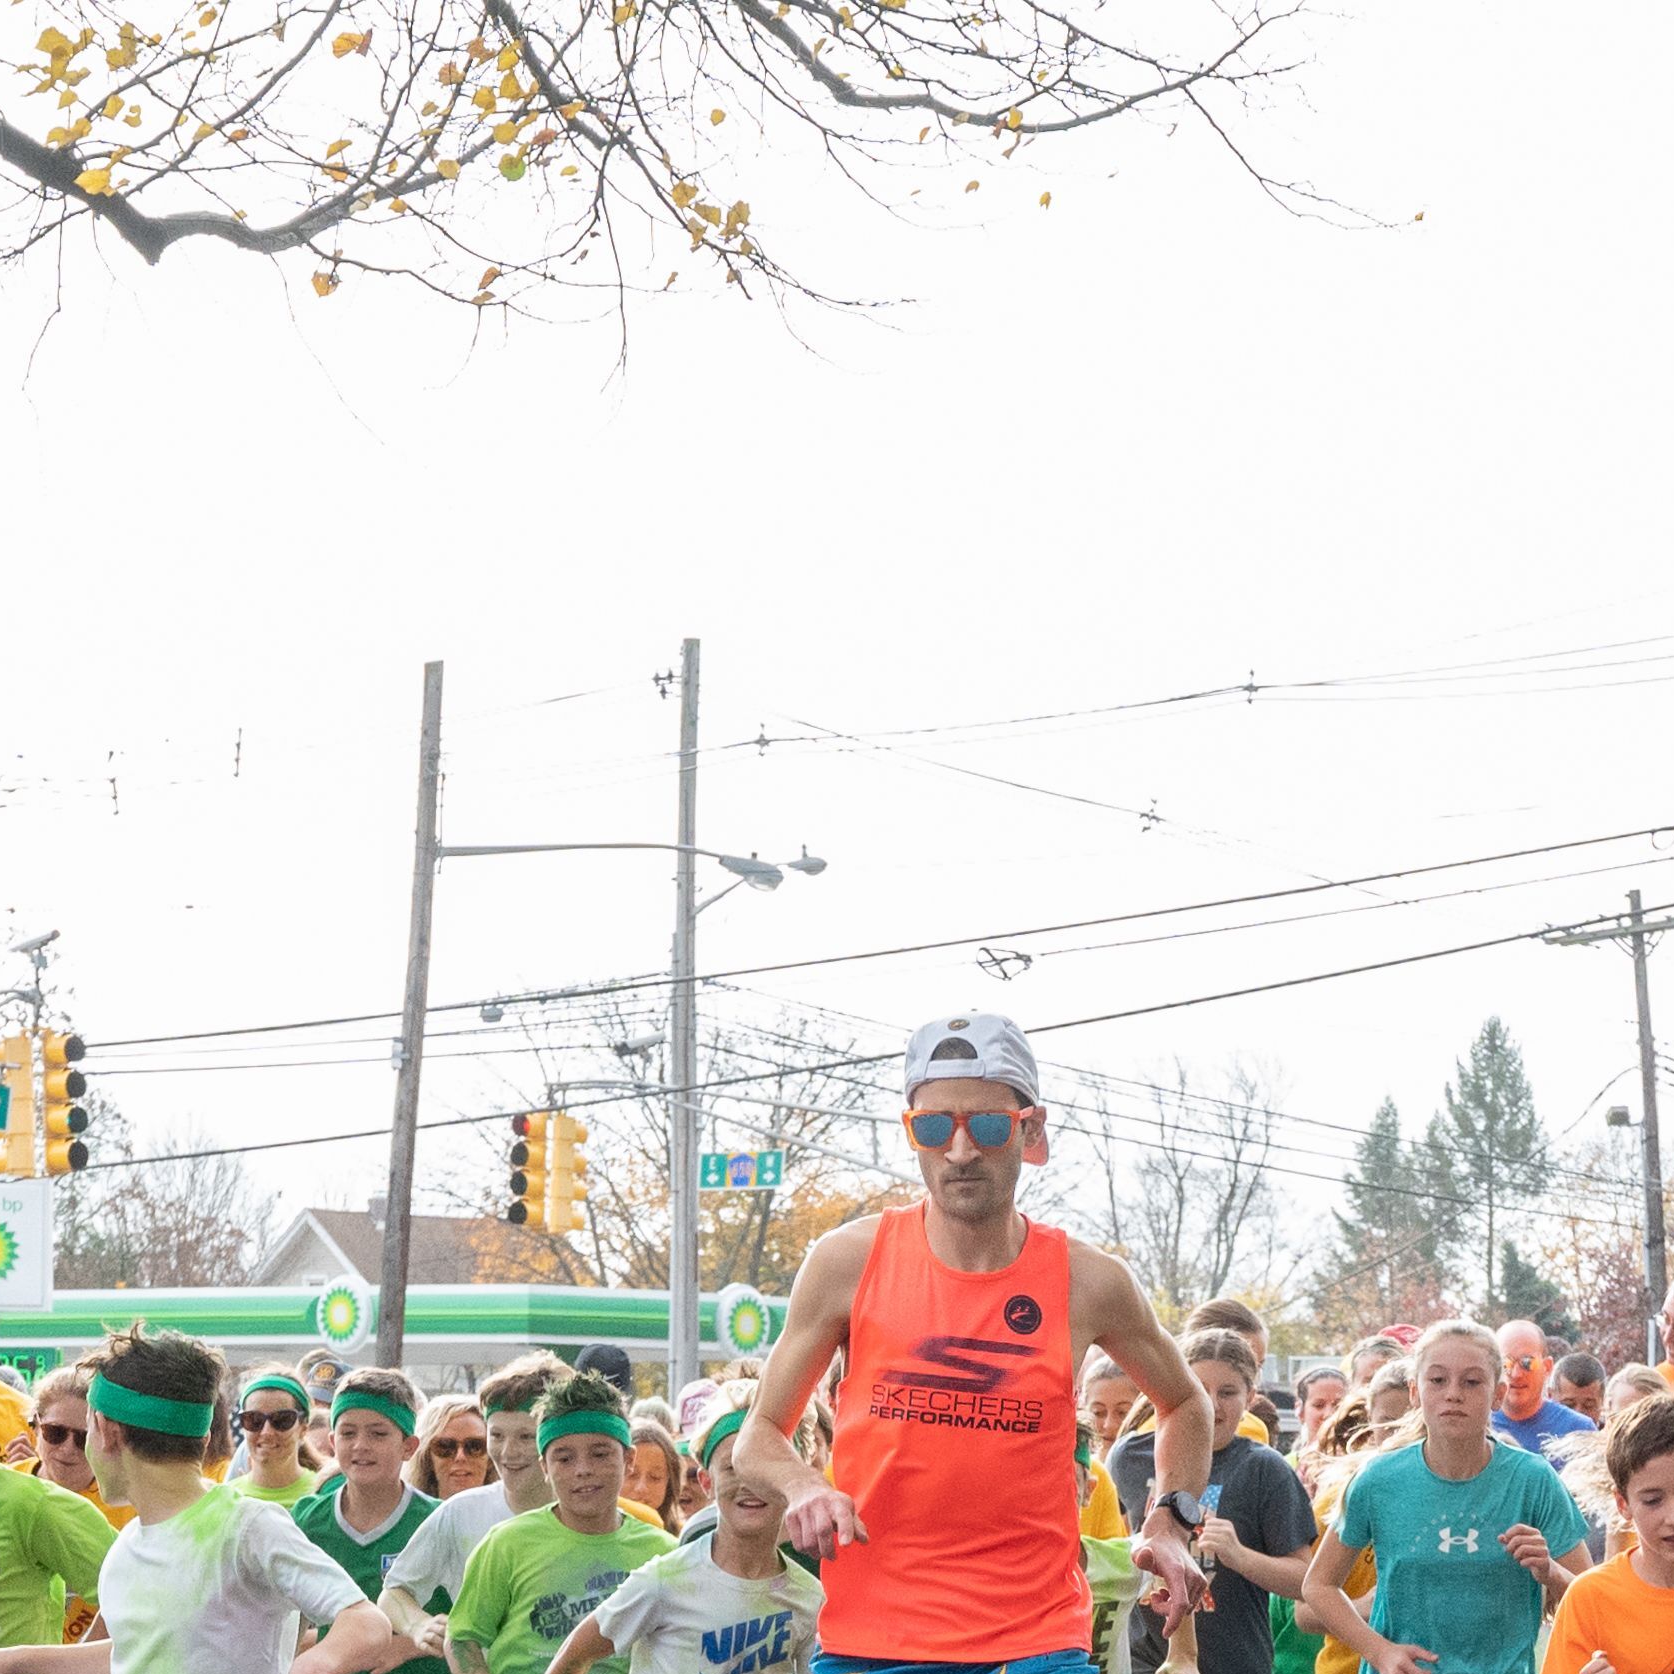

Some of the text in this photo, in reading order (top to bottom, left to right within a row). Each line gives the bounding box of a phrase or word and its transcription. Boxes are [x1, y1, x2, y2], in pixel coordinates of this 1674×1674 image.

[2, 1197, 23, 1214] bp
[871, 1384, 1043, 1421] SKECHERS
[869, 1404, 1040, 1433] PERFORMANCE
